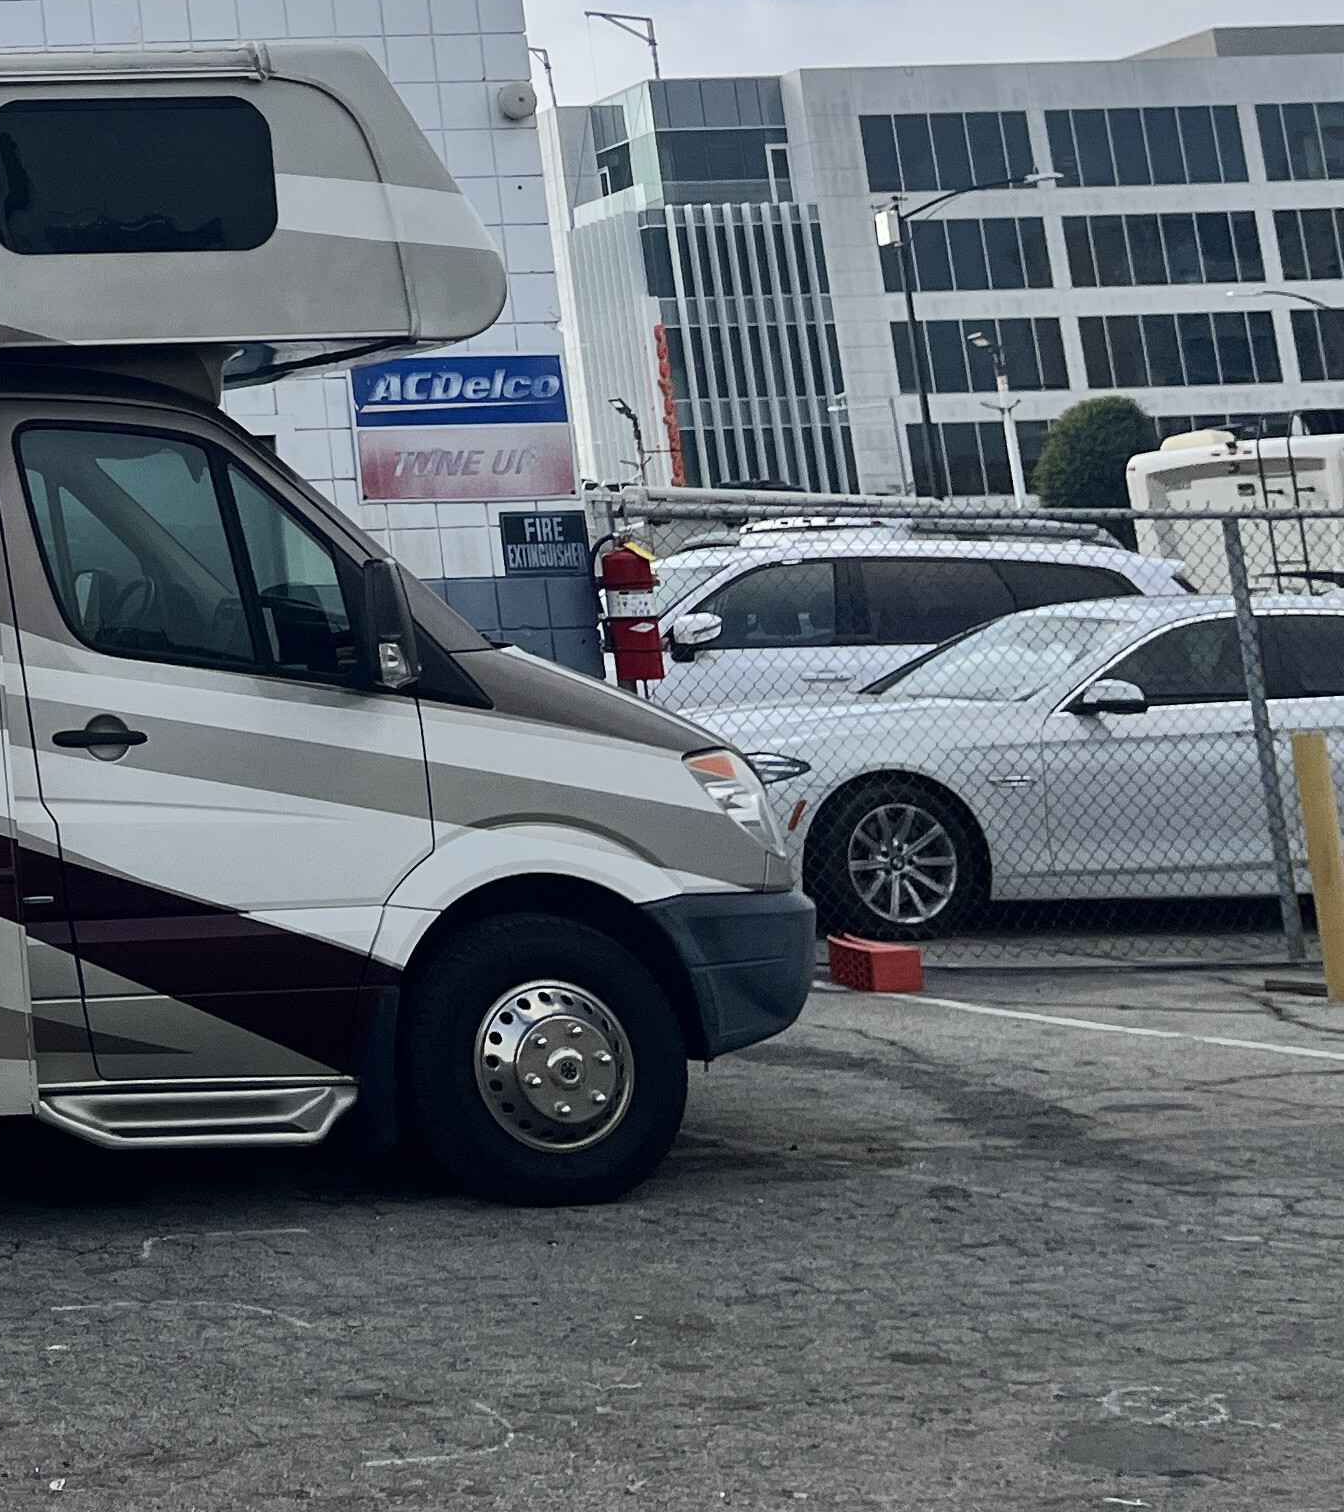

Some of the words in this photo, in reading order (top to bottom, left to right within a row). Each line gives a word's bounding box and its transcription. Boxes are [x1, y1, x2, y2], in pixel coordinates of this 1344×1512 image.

[368, 369, 560, 401] ACDelco
[394, 449, 485, 478] TUNE
[523, 517, 564, 542] FIRE
[507, 542, 587, 568] EXTINGUISHER
